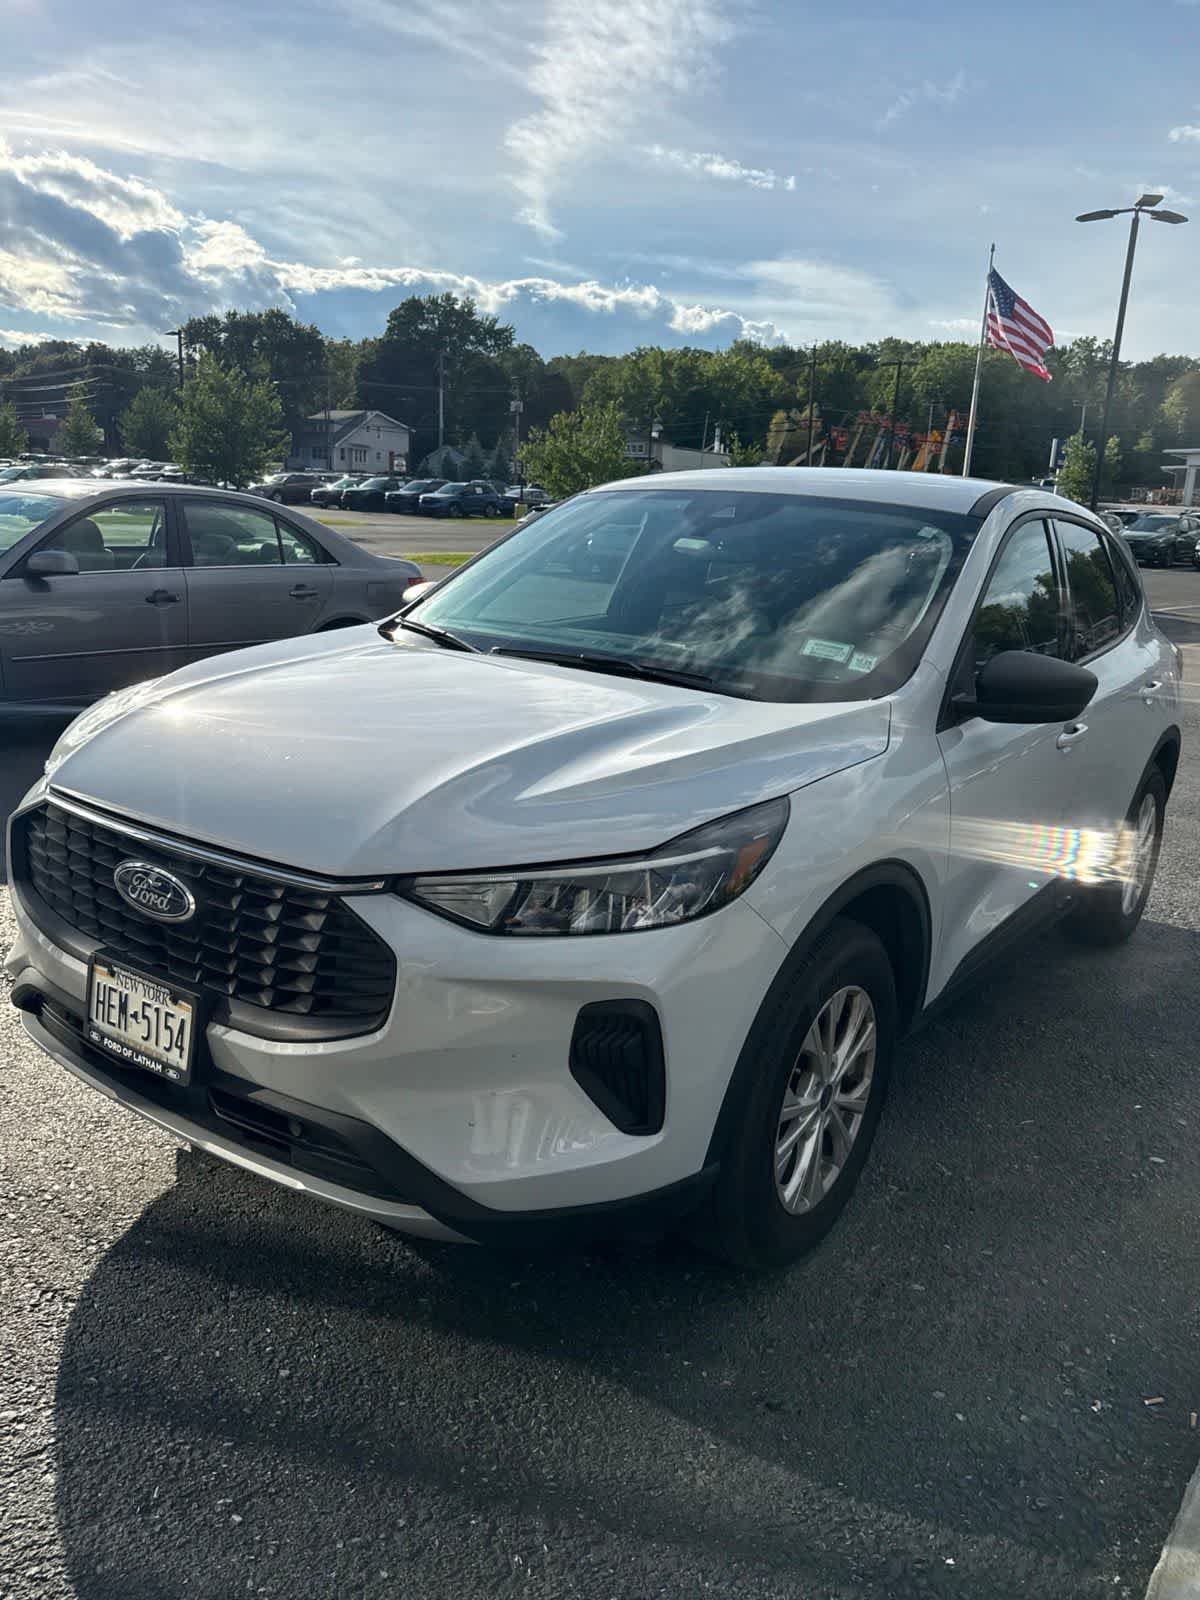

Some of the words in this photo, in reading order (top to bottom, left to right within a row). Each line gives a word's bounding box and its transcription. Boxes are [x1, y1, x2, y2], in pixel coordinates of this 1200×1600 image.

[128, 872, 172, 911] Ford
[115, 972, 138, 994] NEW
[142, 983, 170, 1007] YORK
[95, 981, 129, 1033] HEM
[141, 1001, 186, 1059] 5154
[103, 1037, 121, 1053] FORD
[122, 1047, 133, 1058] OF
[133, 1051, 162, 1073] LATHAM
